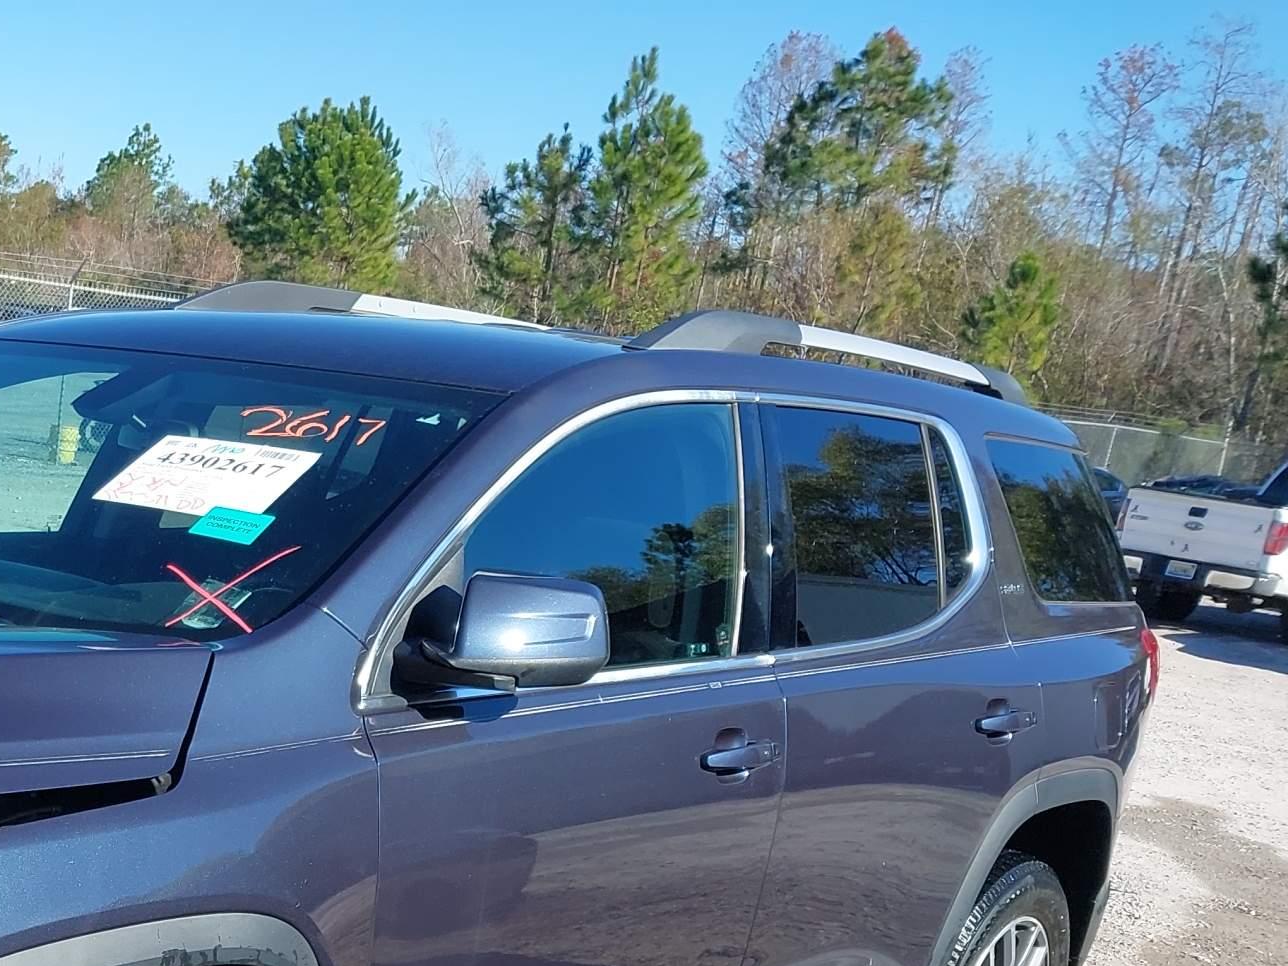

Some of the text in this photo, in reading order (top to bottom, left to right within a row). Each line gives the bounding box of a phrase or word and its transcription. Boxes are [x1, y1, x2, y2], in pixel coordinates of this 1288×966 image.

[240, 406, 386, 446] 2617
[157, 450, 286, 479] 43902617
[205, 521, 252, 534] COMPLETE
[206, 514, 261, 530] INSPECTION
